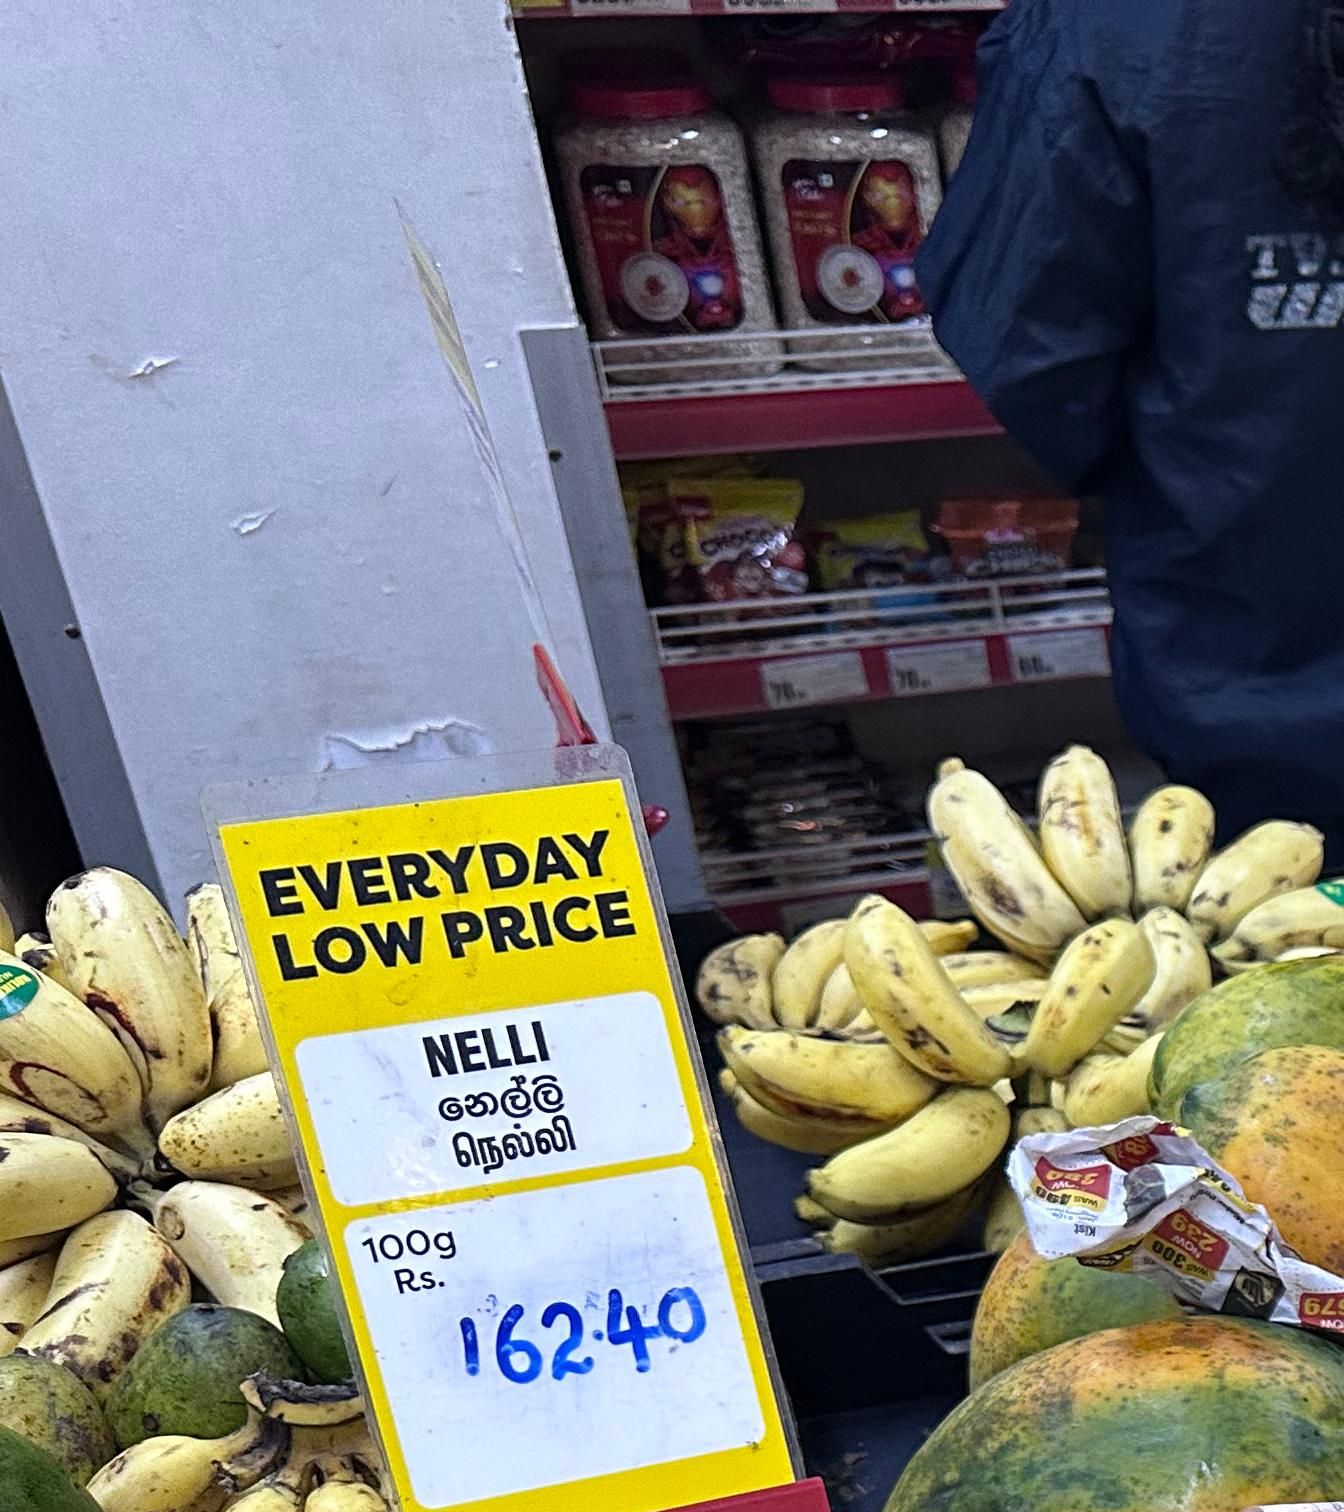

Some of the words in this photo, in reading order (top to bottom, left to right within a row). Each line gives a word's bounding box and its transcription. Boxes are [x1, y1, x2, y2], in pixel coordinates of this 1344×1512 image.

[259, 829, 609, 917] EVERYDAY
[272, 916, 426, 981] LOW
[443, 890, 636, 959] PRICE
[422, 1020, 550, 1078] NELLI
[438, 1074, 565, 1121] නෙල්ලි
[452, 1115, 576, 1174] நெல்லி
[361, 1229, 457, 1267] 100g
[1073, 1223, 1096, 1238] Kist
[1169, 1212, 1218, 1252] 239
[1172, 1234, 1202, 1260] NOW
[1151, 1239, 1187, 1270] 300
[393, 1266, 446, 1295] Rs.
